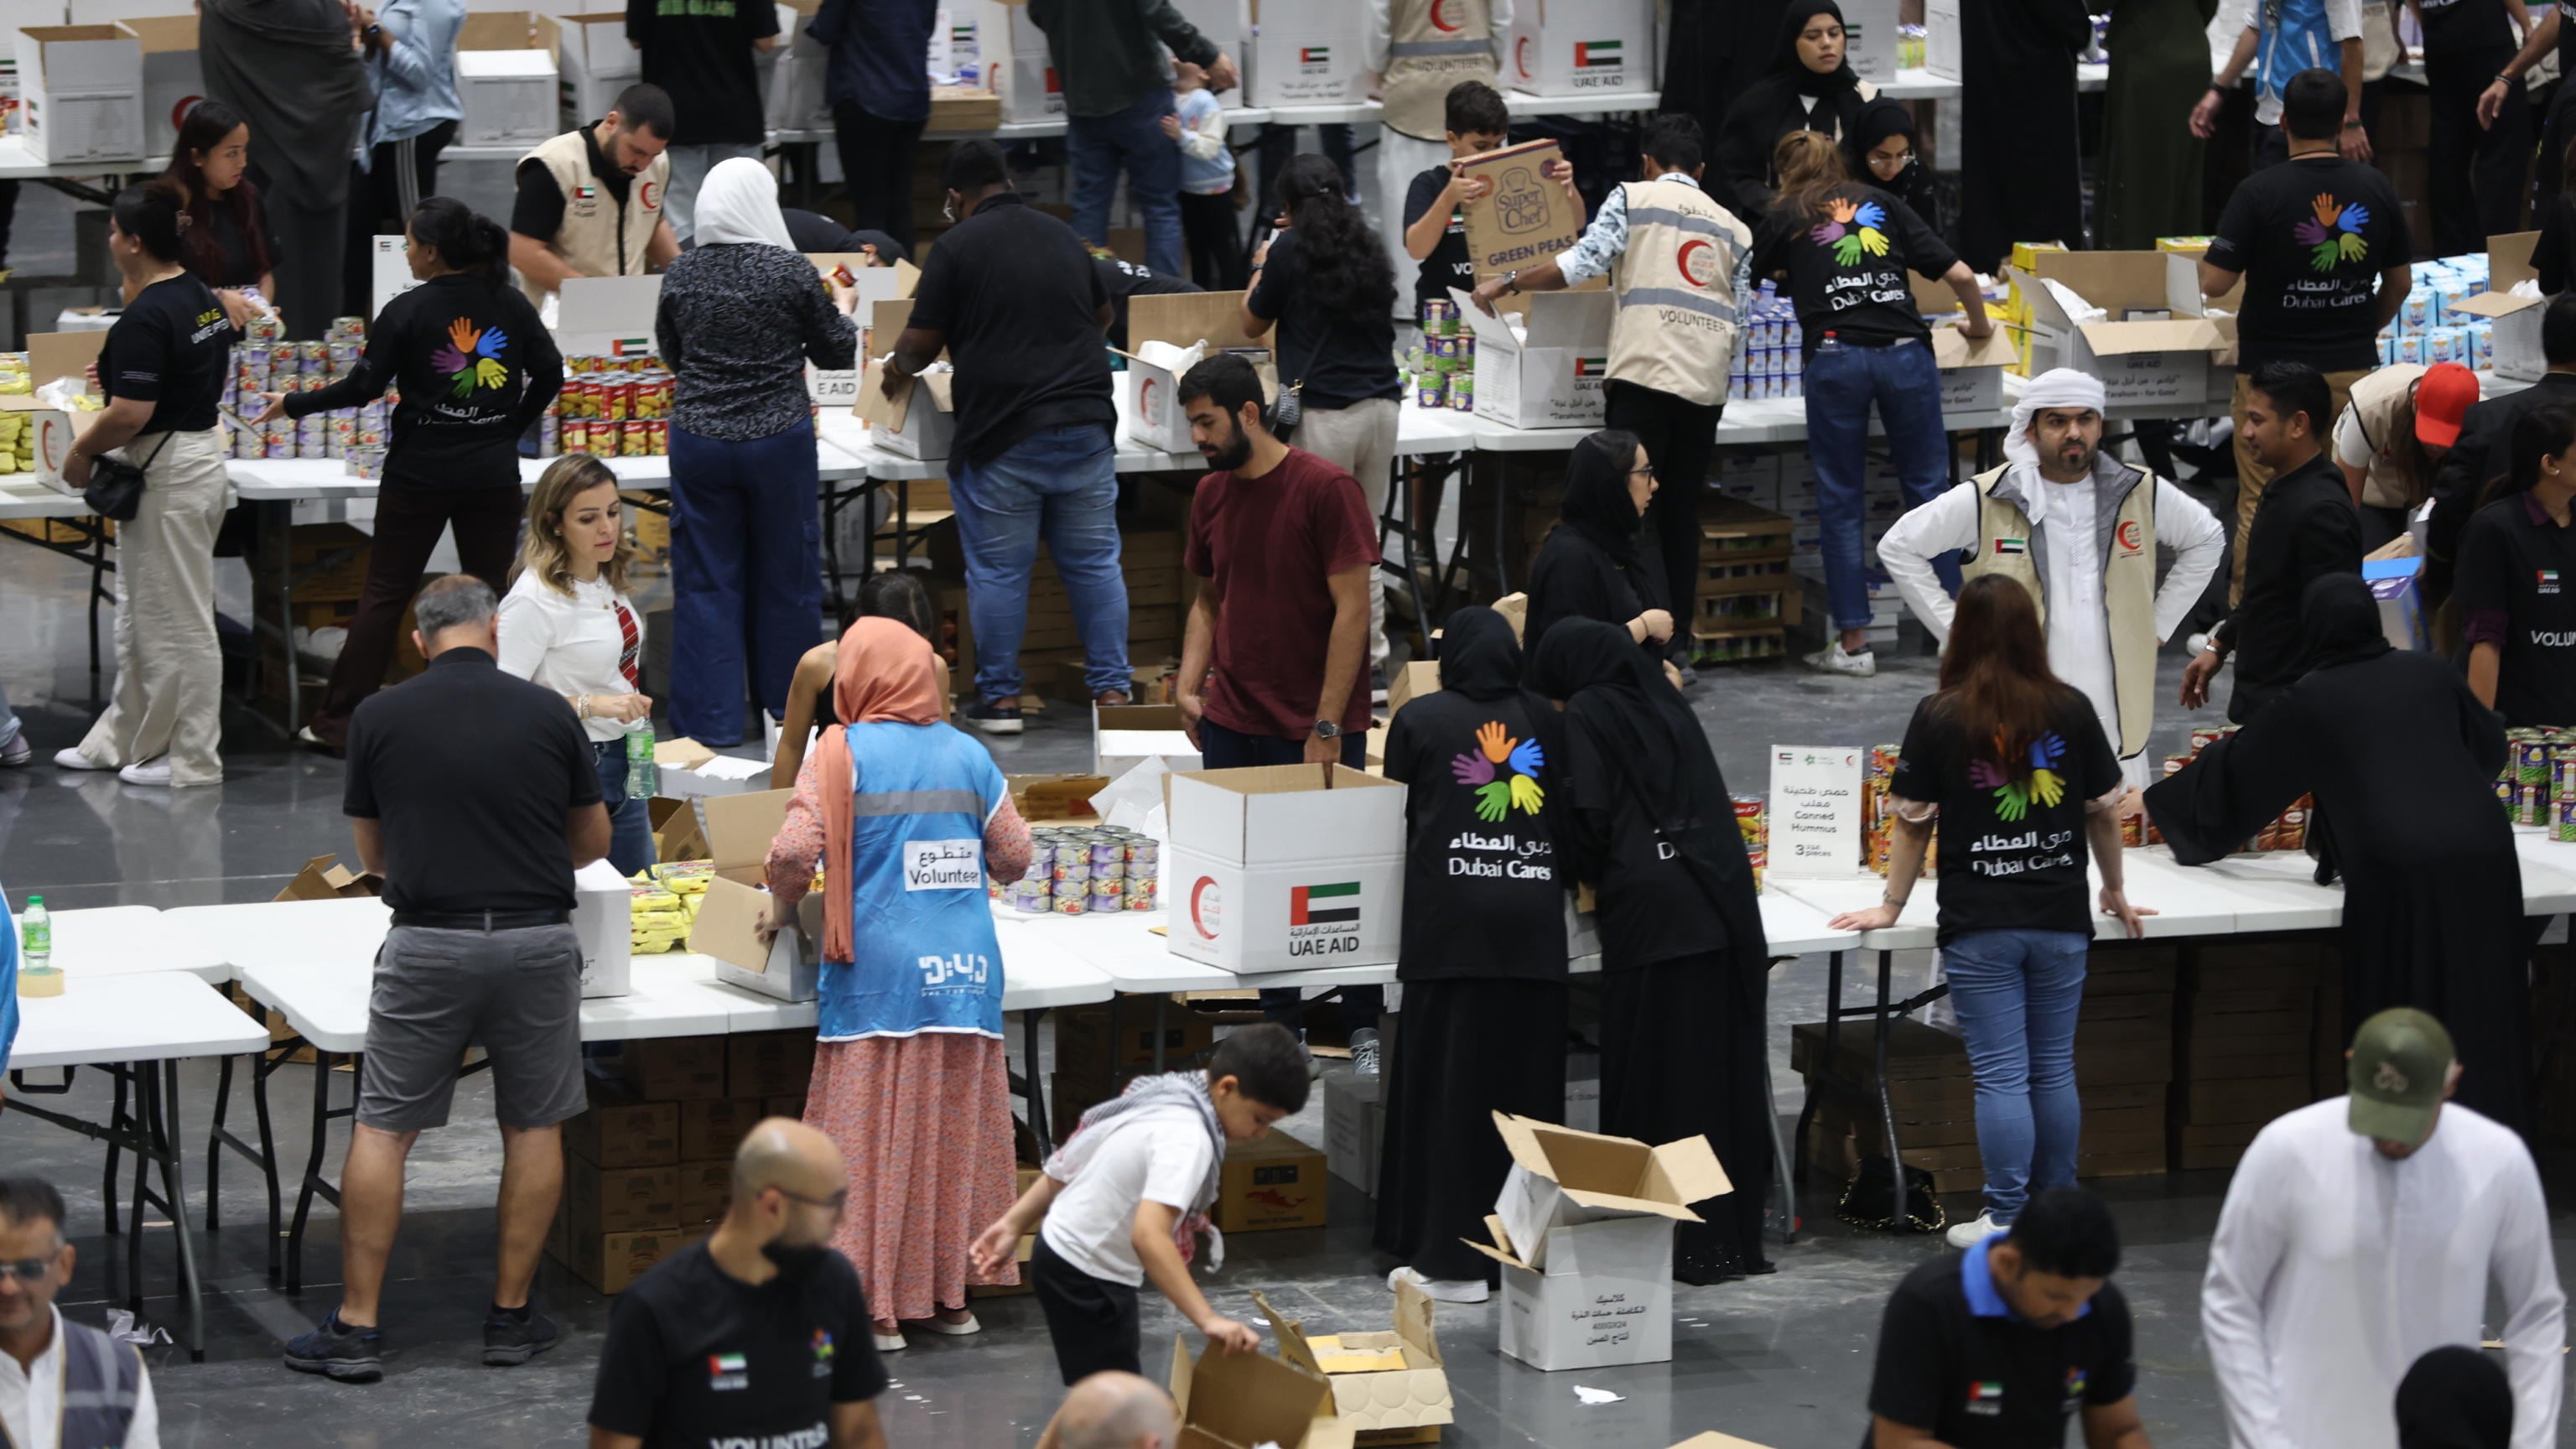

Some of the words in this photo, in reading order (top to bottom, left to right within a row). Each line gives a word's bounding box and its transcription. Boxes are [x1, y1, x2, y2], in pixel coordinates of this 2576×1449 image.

[1498, 190, 1541, 210] Super
[1505, 206, 1544, 230] Chef
[1488, 244, 1535, 267] GREEN
[1537, 235, 1574, 253] PEAS
[1825, 272, 1873, 294] العطاء
[2283, 294, 2326, 309] Dubai
[1659, 309, 1727, 335] VOLUNTEER
[1794, 810, 1835, 820] Canned
[1791, 823, 1837, 834] Hummus
[1448, 832, 1515, 851] العطاء
[1517, 840, 1552, 860] دبي
[1795, 844, 1805, 856] 3
[1970, 831, 2038, 852] العطاء
[919, 845, 973, 867] متطوع
[910, 869, 979, 886] Volunteer
[1448, 857, 1503, 877] Dubai
[1506, 860, 1551, 880] Cares
[1321, 922, 1361, 934] المساعدات
[1290, 938, 1326, 957] UAE
[1328, 936, 1360, 954] AID
